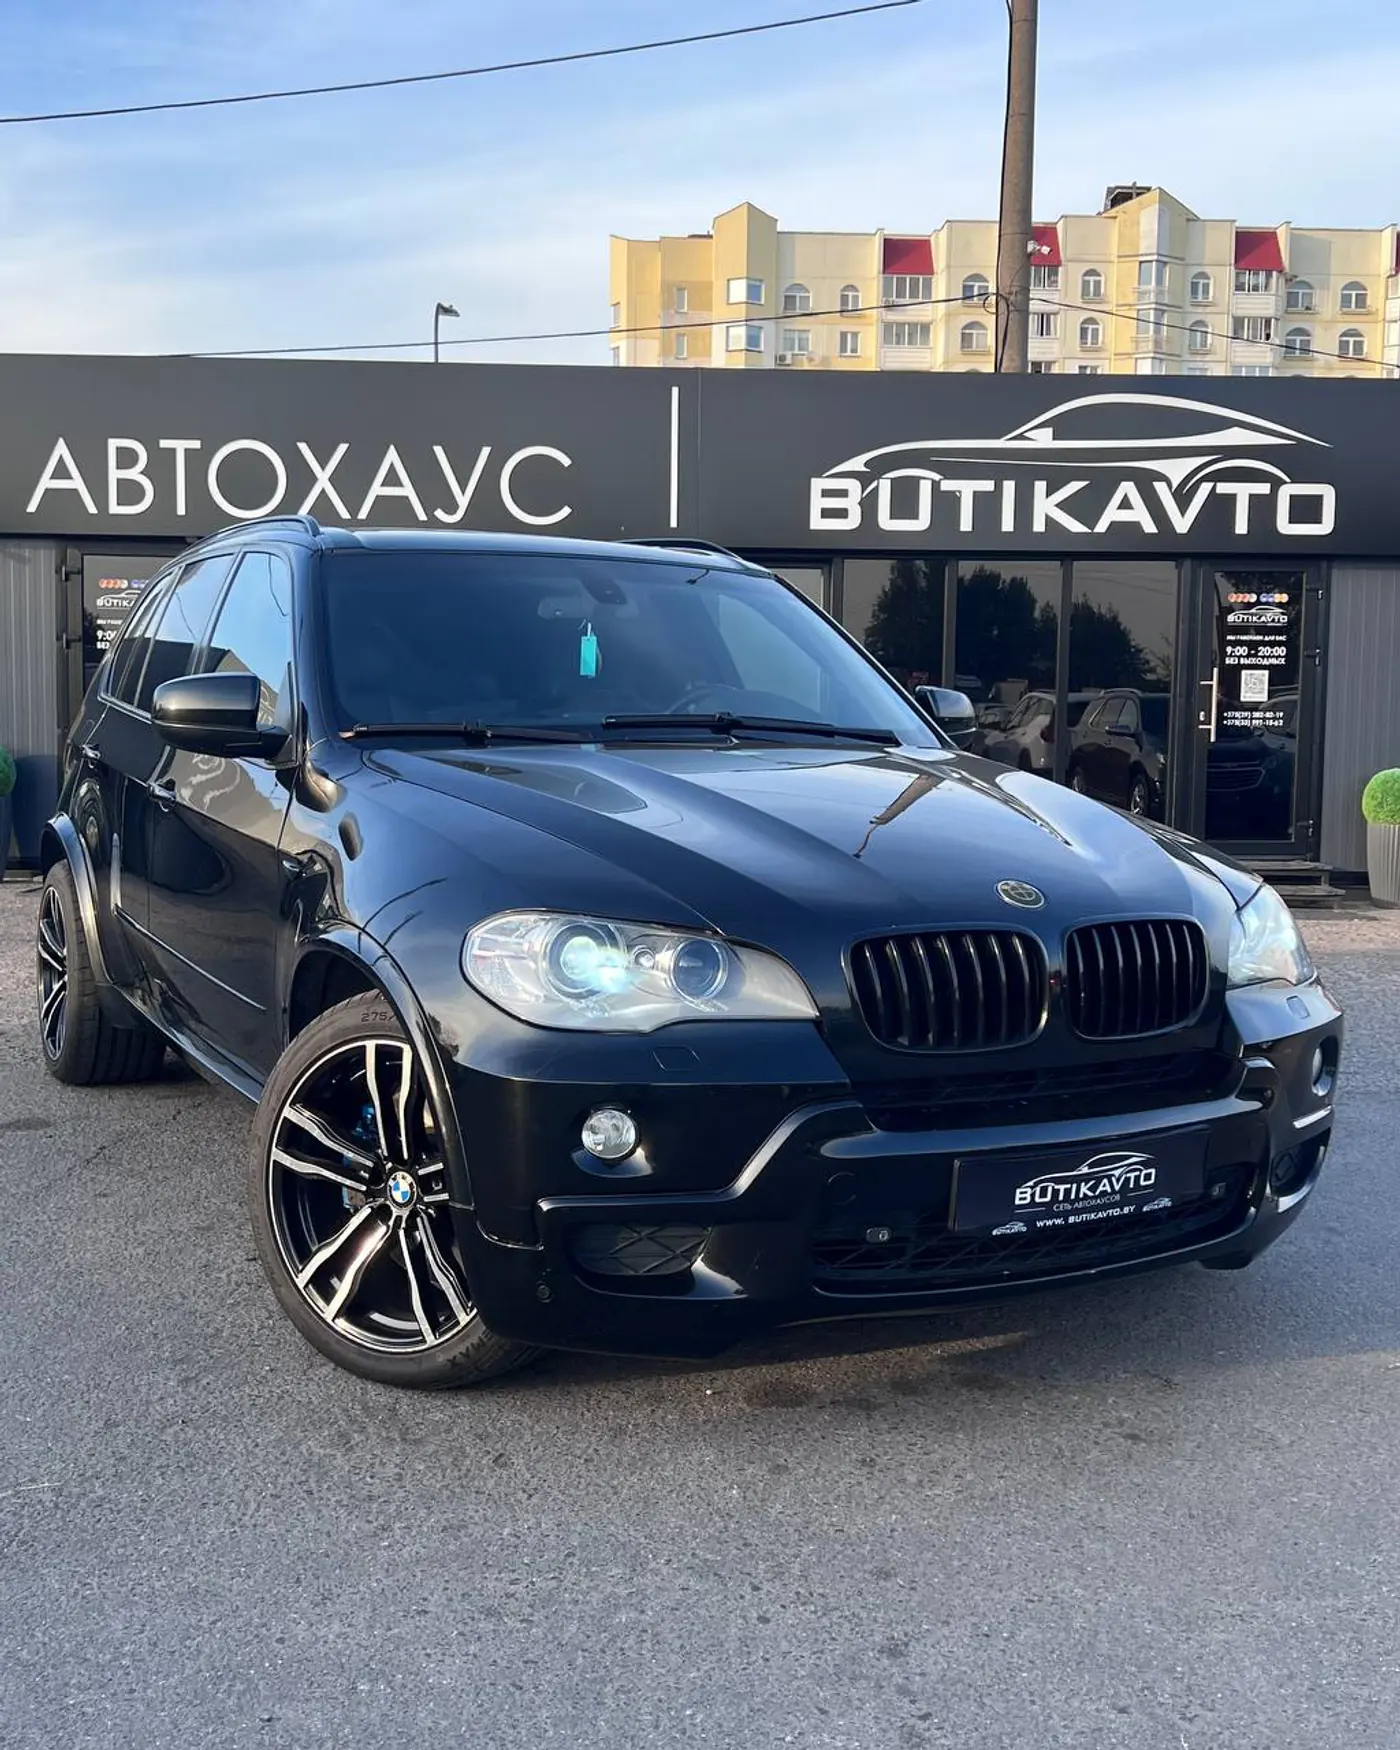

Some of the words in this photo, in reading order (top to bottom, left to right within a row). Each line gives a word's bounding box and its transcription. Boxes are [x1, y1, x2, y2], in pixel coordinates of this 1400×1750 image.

[26, 437, 573, 525] АВТОХАУС
[809, 476, 1336, 537] BUTIKAVTO
[1226, 646, 1248, 656] 9:00
[1257, 646, 1287, 656] 20:00
[1240, 657, 1286, 665] ВЫХОДНЫХ
[1014, 1168, 1156, 1206] BUTIKAVTO
[1053, 1202, 1072, 1212] СЕТЬ
[1073, 1194, 1121, 1210] АВТОХАУСОВ
